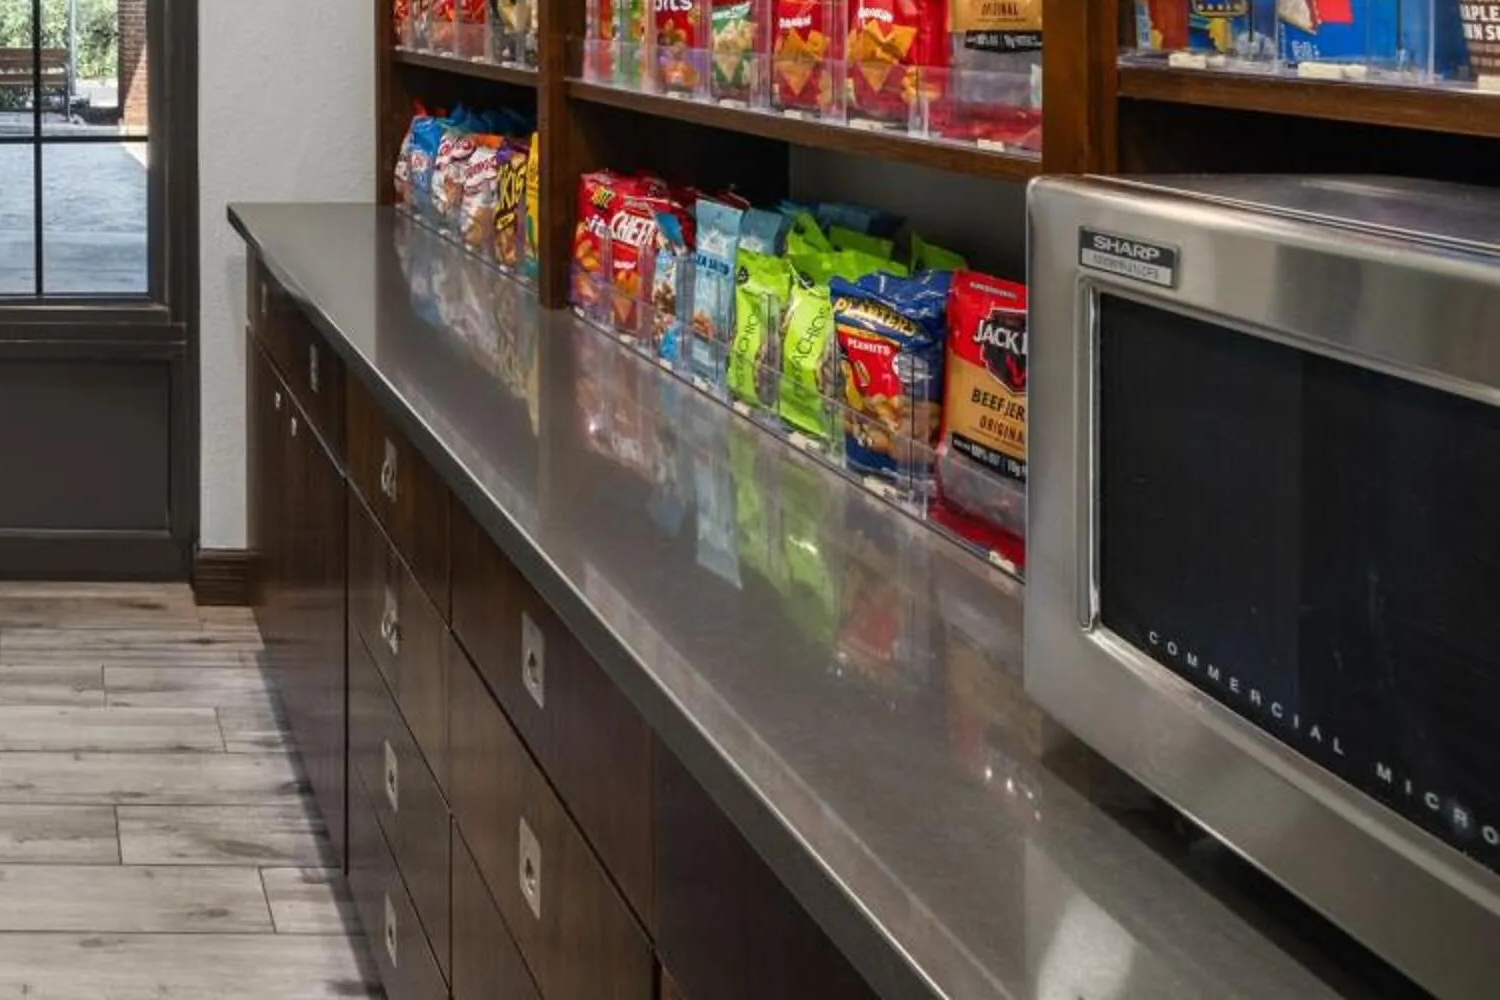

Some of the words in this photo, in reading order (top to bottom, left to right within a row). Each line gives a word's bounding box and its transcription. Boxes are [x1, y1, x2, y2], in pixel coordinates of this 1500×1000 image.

[1092, 234, 1161, 261] SHARP
[972, 319, 1021, 355] JACK
[971, 387, 1005, 414] BEEF
[1004, 398, 1027, 424] JER
[978, 414, 1027, 444] ORIGINA
[1148, 630, 1345, 756] COMMERCIAL
[1375, 761, 1500, 846] MICRO
